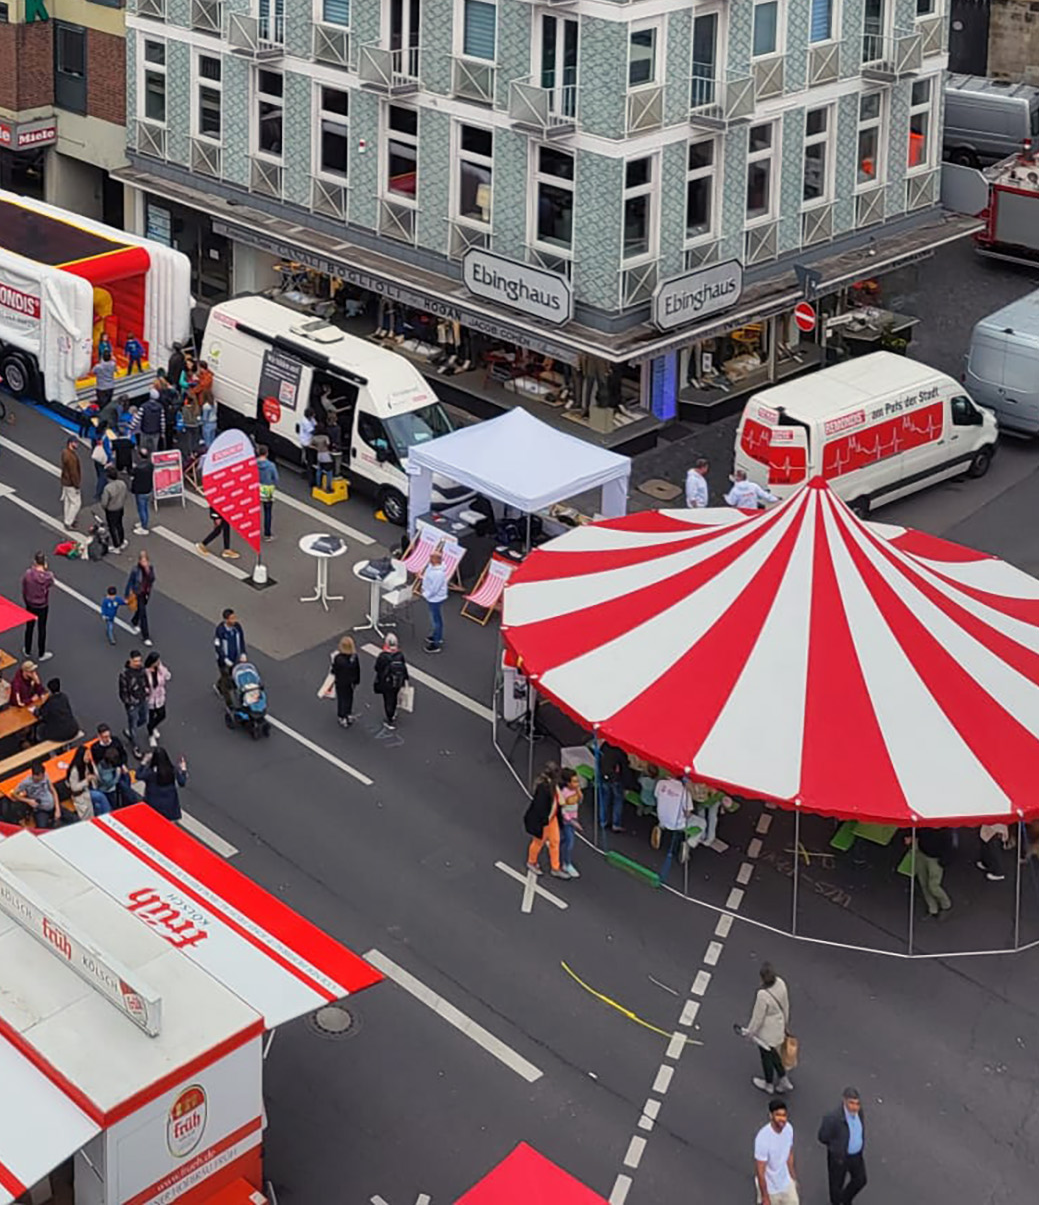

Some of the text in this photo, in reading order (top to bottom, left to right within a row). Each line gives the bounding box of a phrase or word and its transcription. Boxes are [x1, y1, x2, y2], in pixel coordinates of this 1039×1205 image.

[18, 129, 54, 146] Miele
[327, 264, 401, 300] BOGLIOLI
[472, 262, 561, 312] Ebinghaus
[424, 298, 460, 320] HOGAN
[665, 278, 735, 316] Ebinghaus
[919, 387, 939, 403] Stadt
